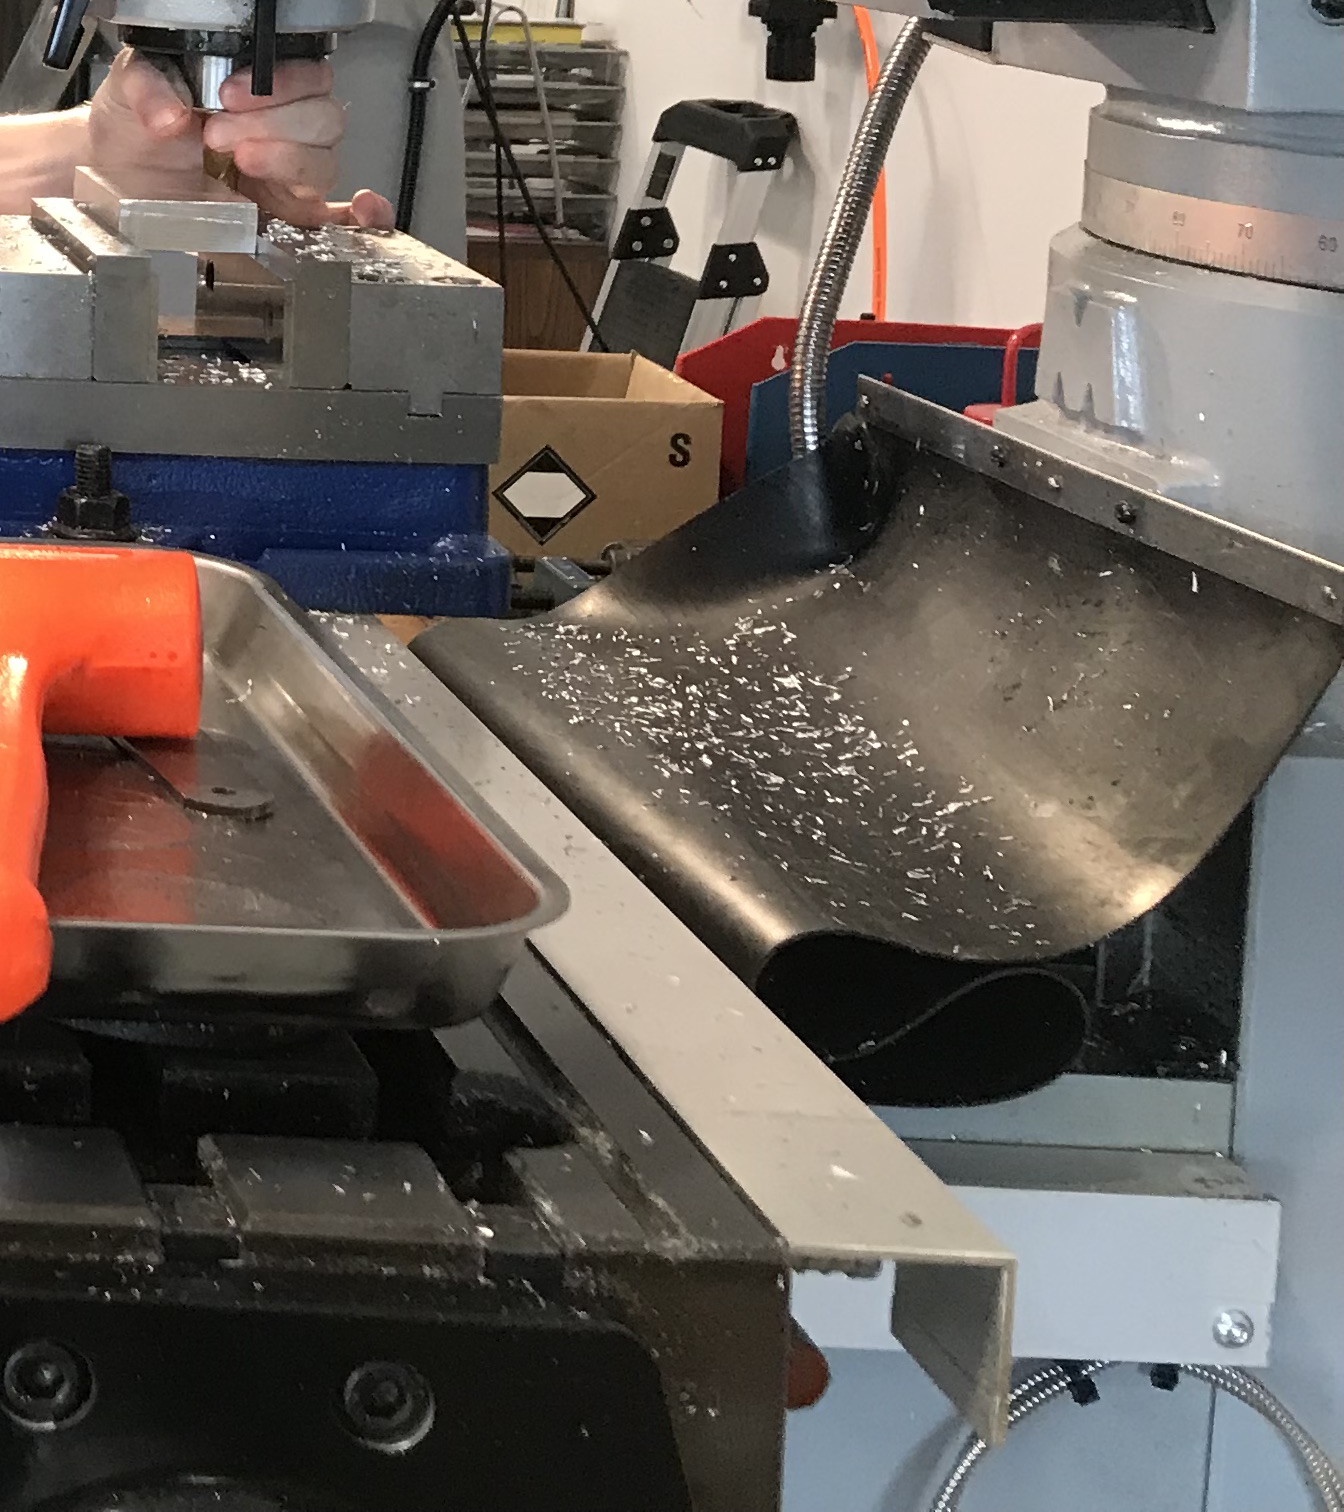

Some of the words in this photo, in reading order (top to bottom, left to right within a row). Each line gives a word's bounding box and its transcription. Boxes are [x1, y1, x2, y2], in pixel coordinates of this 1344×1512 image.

[1237, 222, 1254, 239] 70
[1317, 234, 1338, 252] 60
[668, 432, 692, 468] S
